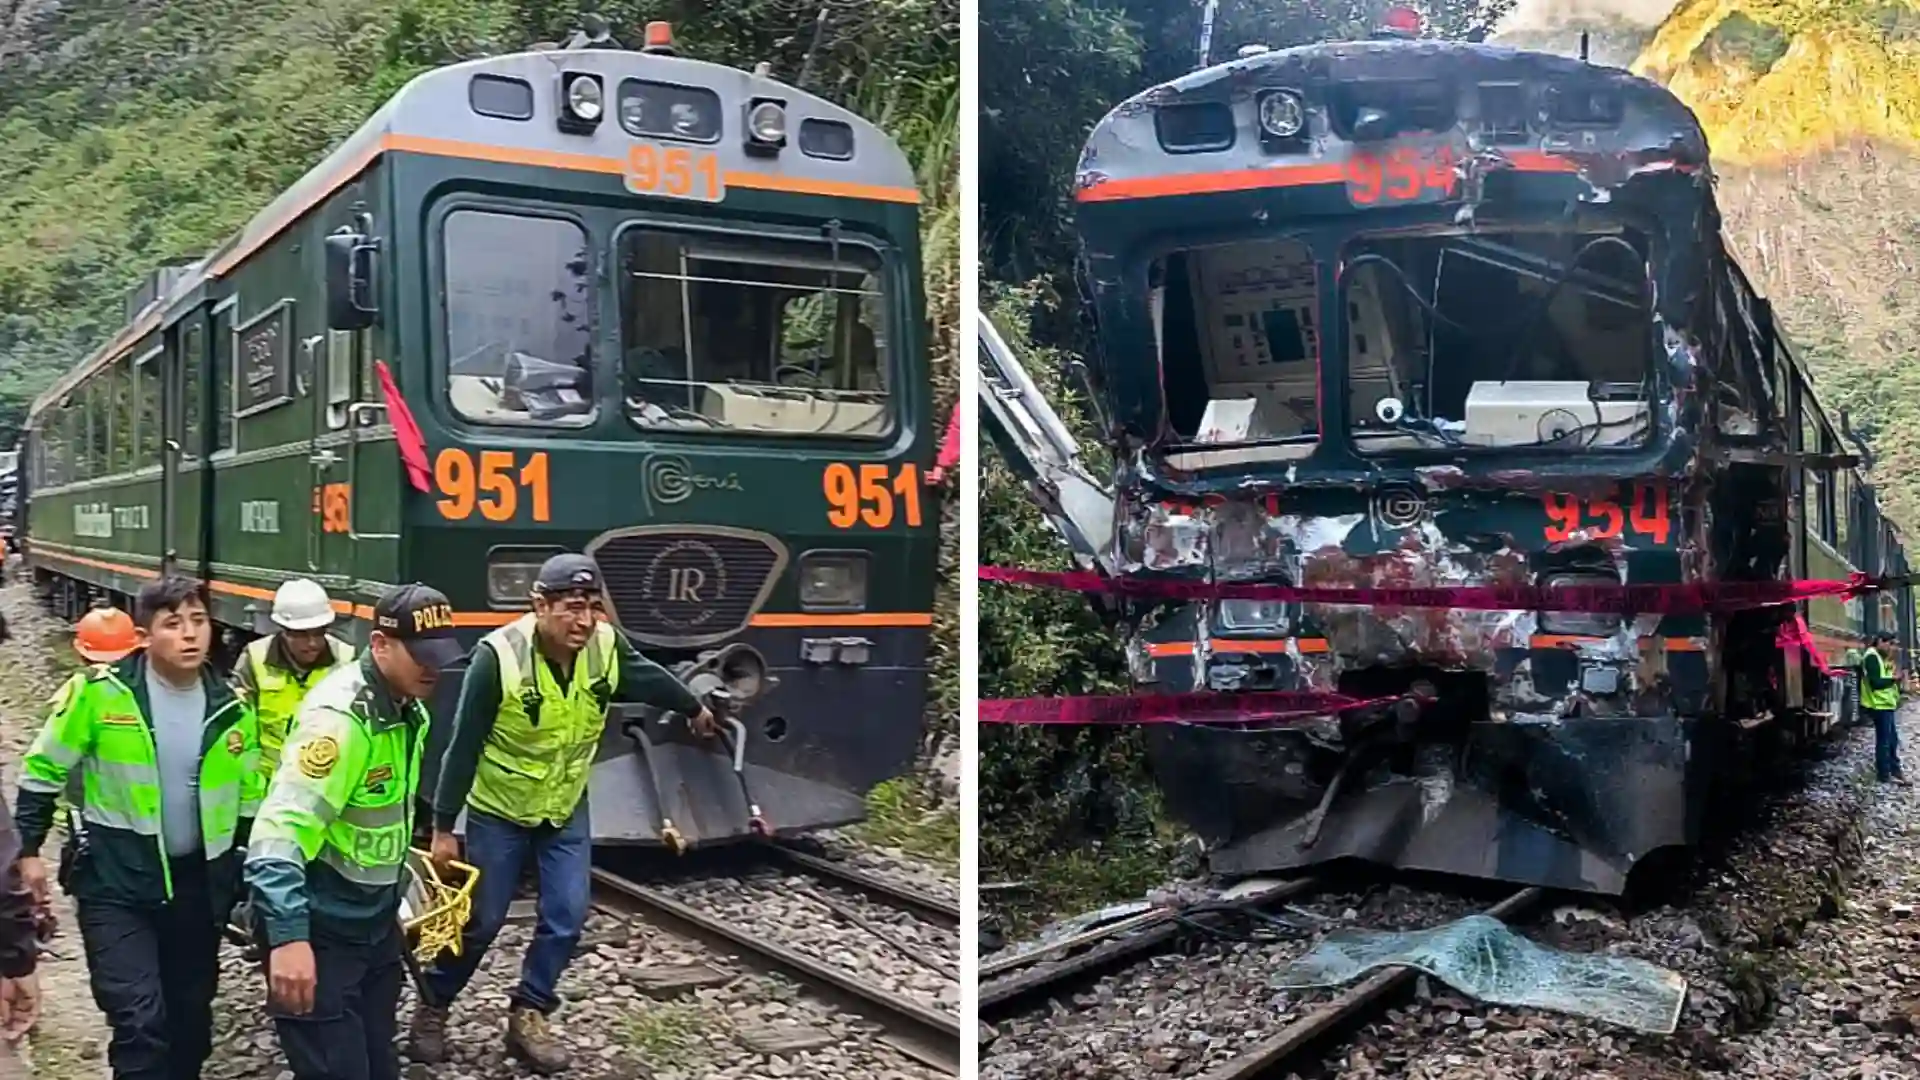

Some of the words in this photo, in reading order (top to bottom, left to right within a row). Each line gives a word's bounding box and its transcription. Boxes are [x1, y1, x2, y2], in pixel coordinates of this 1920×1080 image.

[628, 144, 719, 201] 951
[1349, 145, 1456, 204] 954
[435, 447, 550, 521] 951
[823, 462, 922, 528] 951
[1543, 481, 1670, 545] 954
[667, 567, 706, 604] IR
